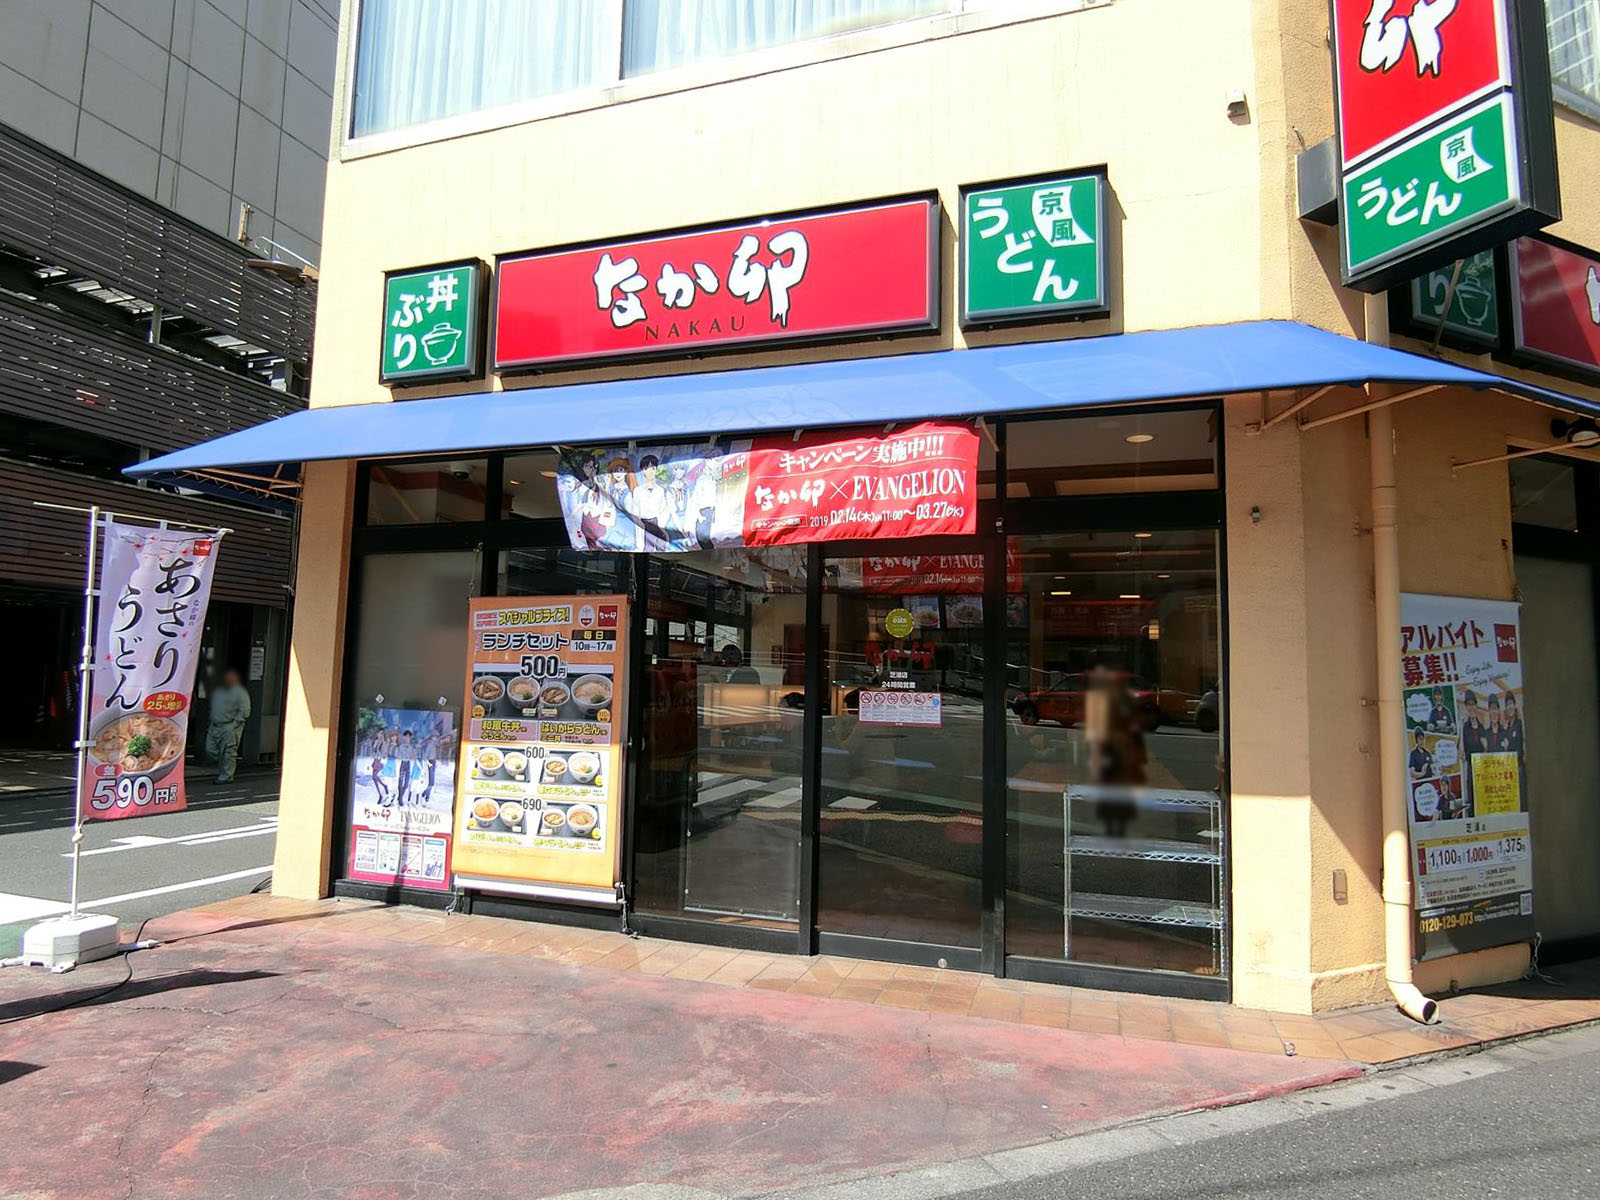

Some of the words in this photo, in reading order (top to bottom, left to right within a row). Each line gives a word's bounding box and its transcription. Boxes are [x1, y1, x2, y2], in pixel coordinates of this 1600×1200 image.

[1446, 135, 1477, 179] 京風
[1039, 191, 1076, 242] 京風
[1357, 176, 1462, 225] うどん
[972, 197, 1079, 302] うどん
[593, 230, 809, 329] なか卯
[645, 315, 746, 341] NAKAU
[851, 467, 967, 501] EVANGELION
[154, 557, 201, 689] あさり
[1400, 620, 1484, 654] アルバイト
[105, 583, 144, 710] うどん
[482, 633, 570, 651] ランチセット
[1402, 652, 1459, 687] 募集!!
[541, 722, 600, 735] はいからうどん
[526, 747, 545, 759] 600
[91, 776, 170, 810] 590円
[522, 799, 542, 811] 690
